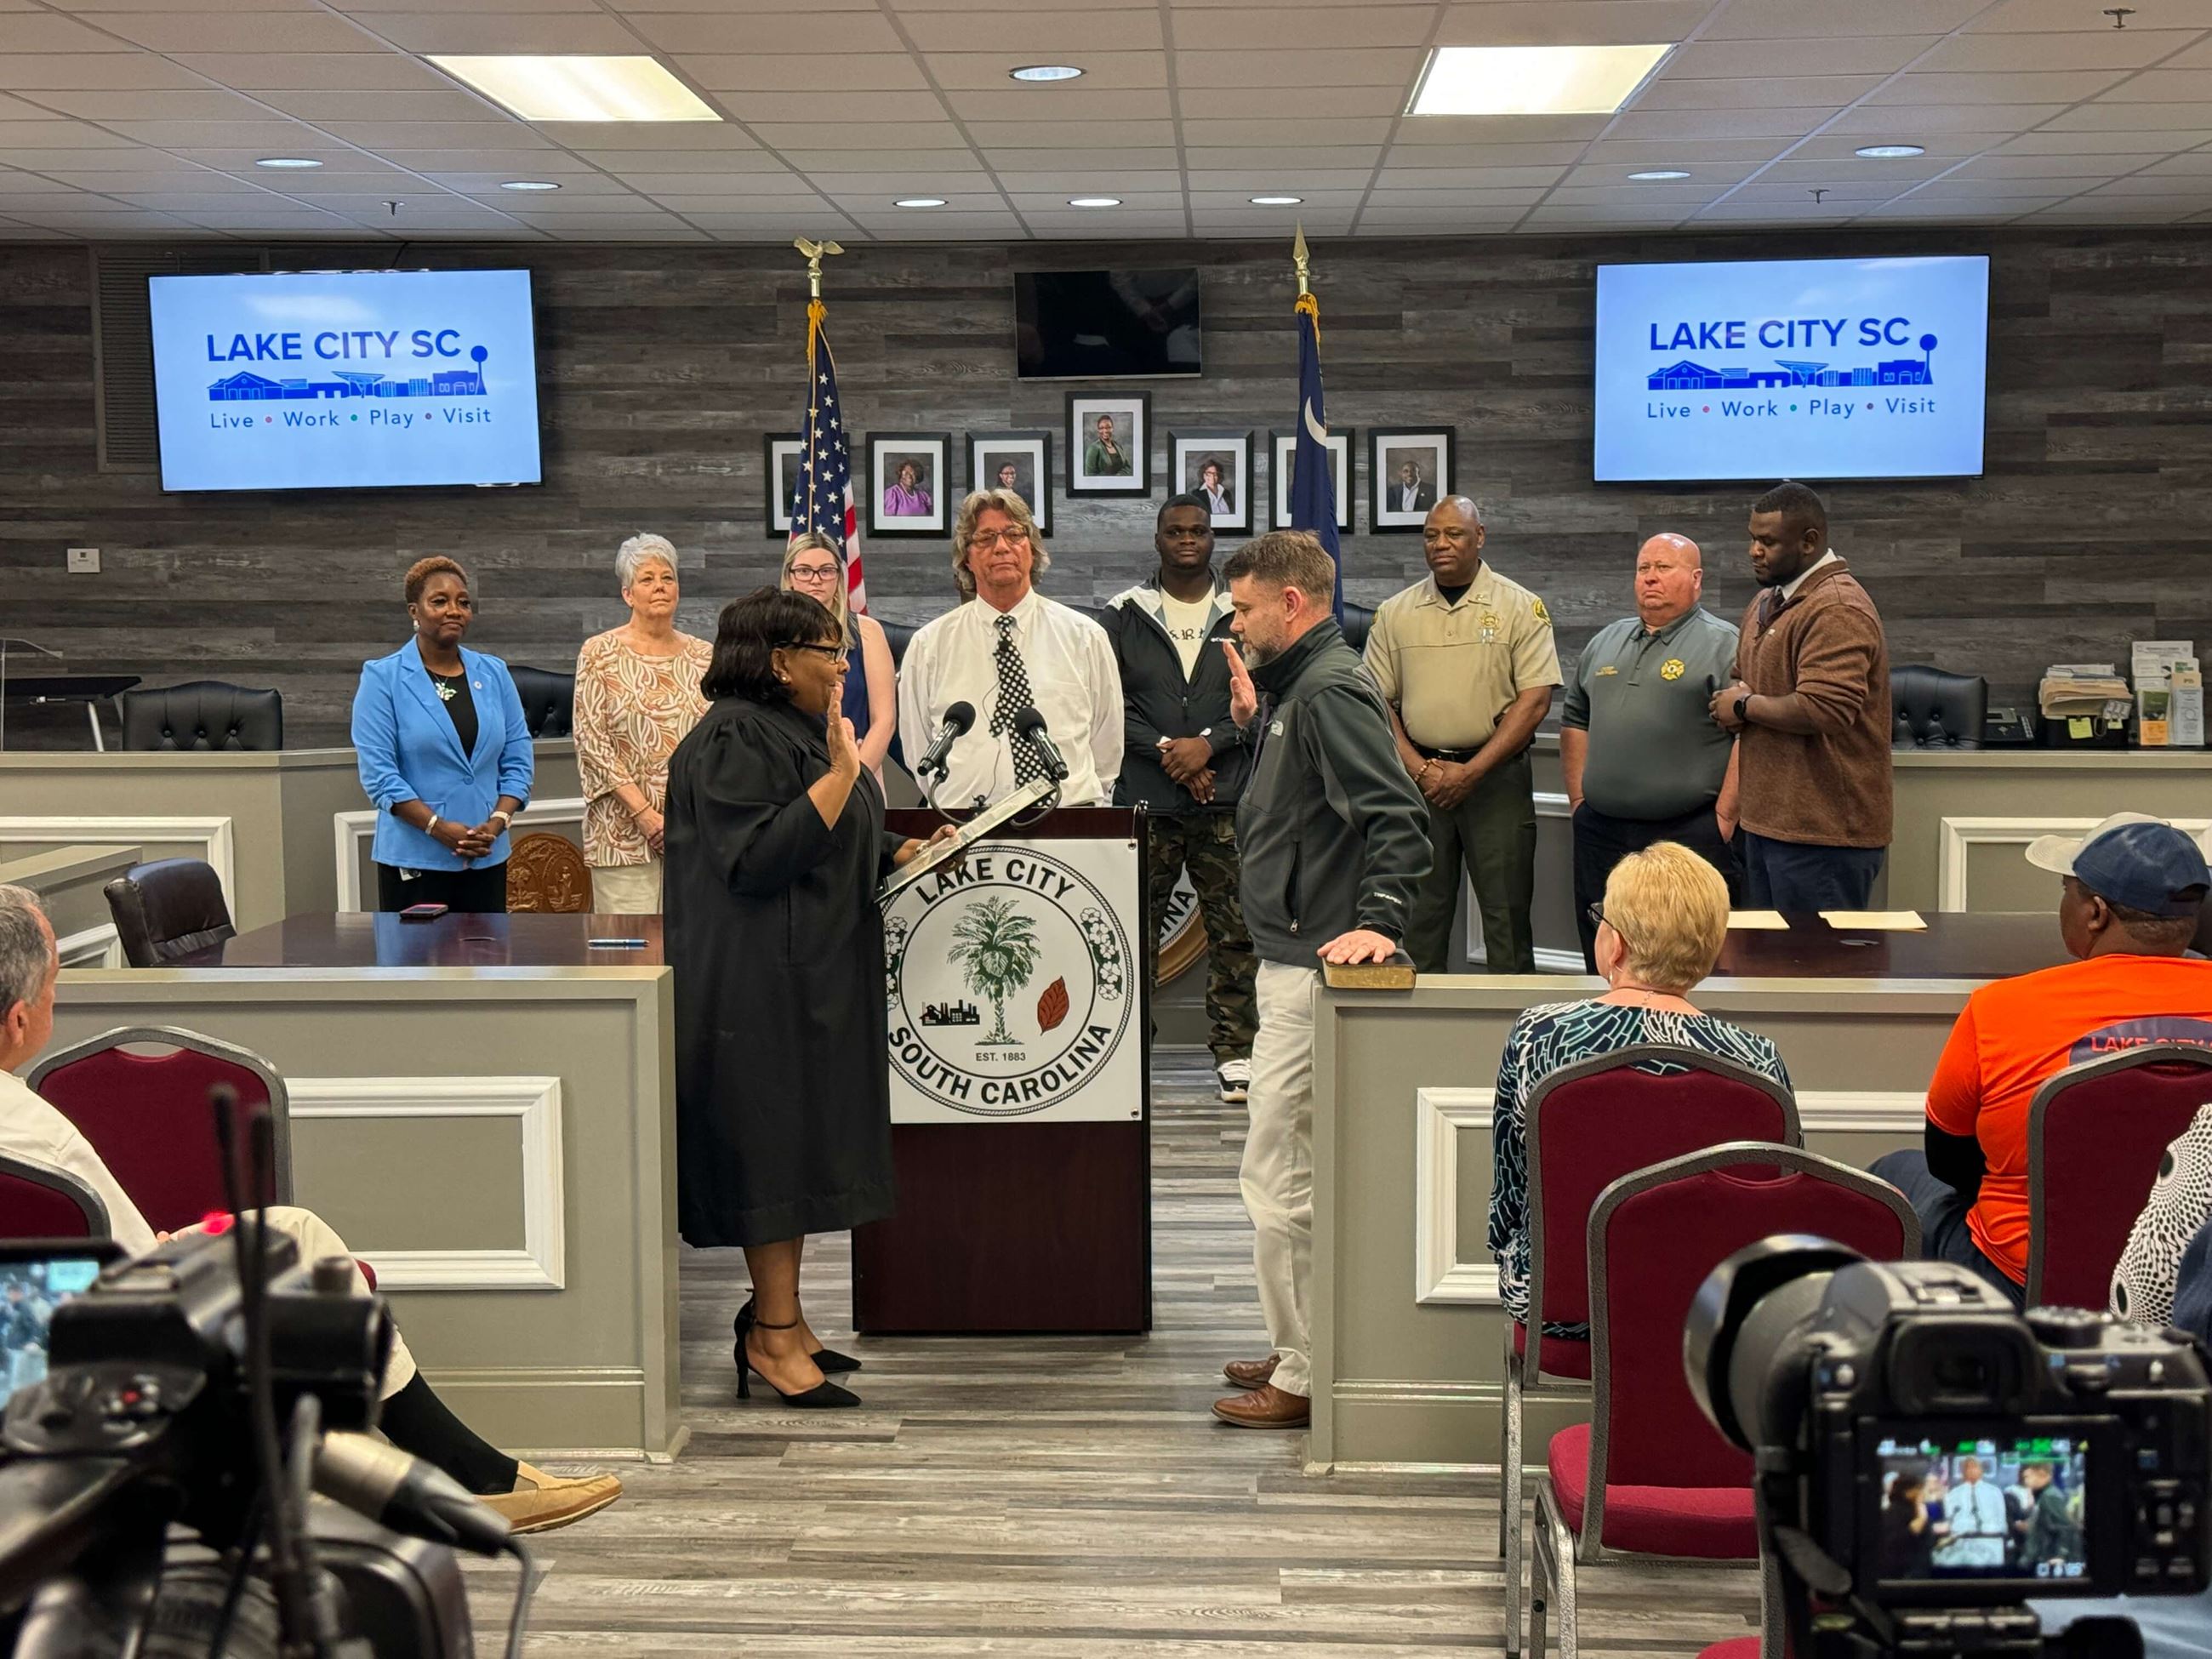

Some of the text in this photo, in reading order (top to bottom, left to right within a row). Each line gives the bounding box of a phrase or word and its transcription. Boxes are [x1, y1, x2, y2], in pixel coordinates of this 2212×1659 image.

[207, 328, 461, 362] LAKE CITY SC
[1650, 317, 1910, 351] LAKE CITY SC
[210, 408, 492, 429] Live Work Play Visit
[1647, 397, 1936, 419] Live Work Play Visit
[915, 858, 1075, 905] LAKE CITY
[889, 1024, 1112, 1104] SOUTH CAROLINA
[975, 1052, 1027, 1062] EST. 1883
